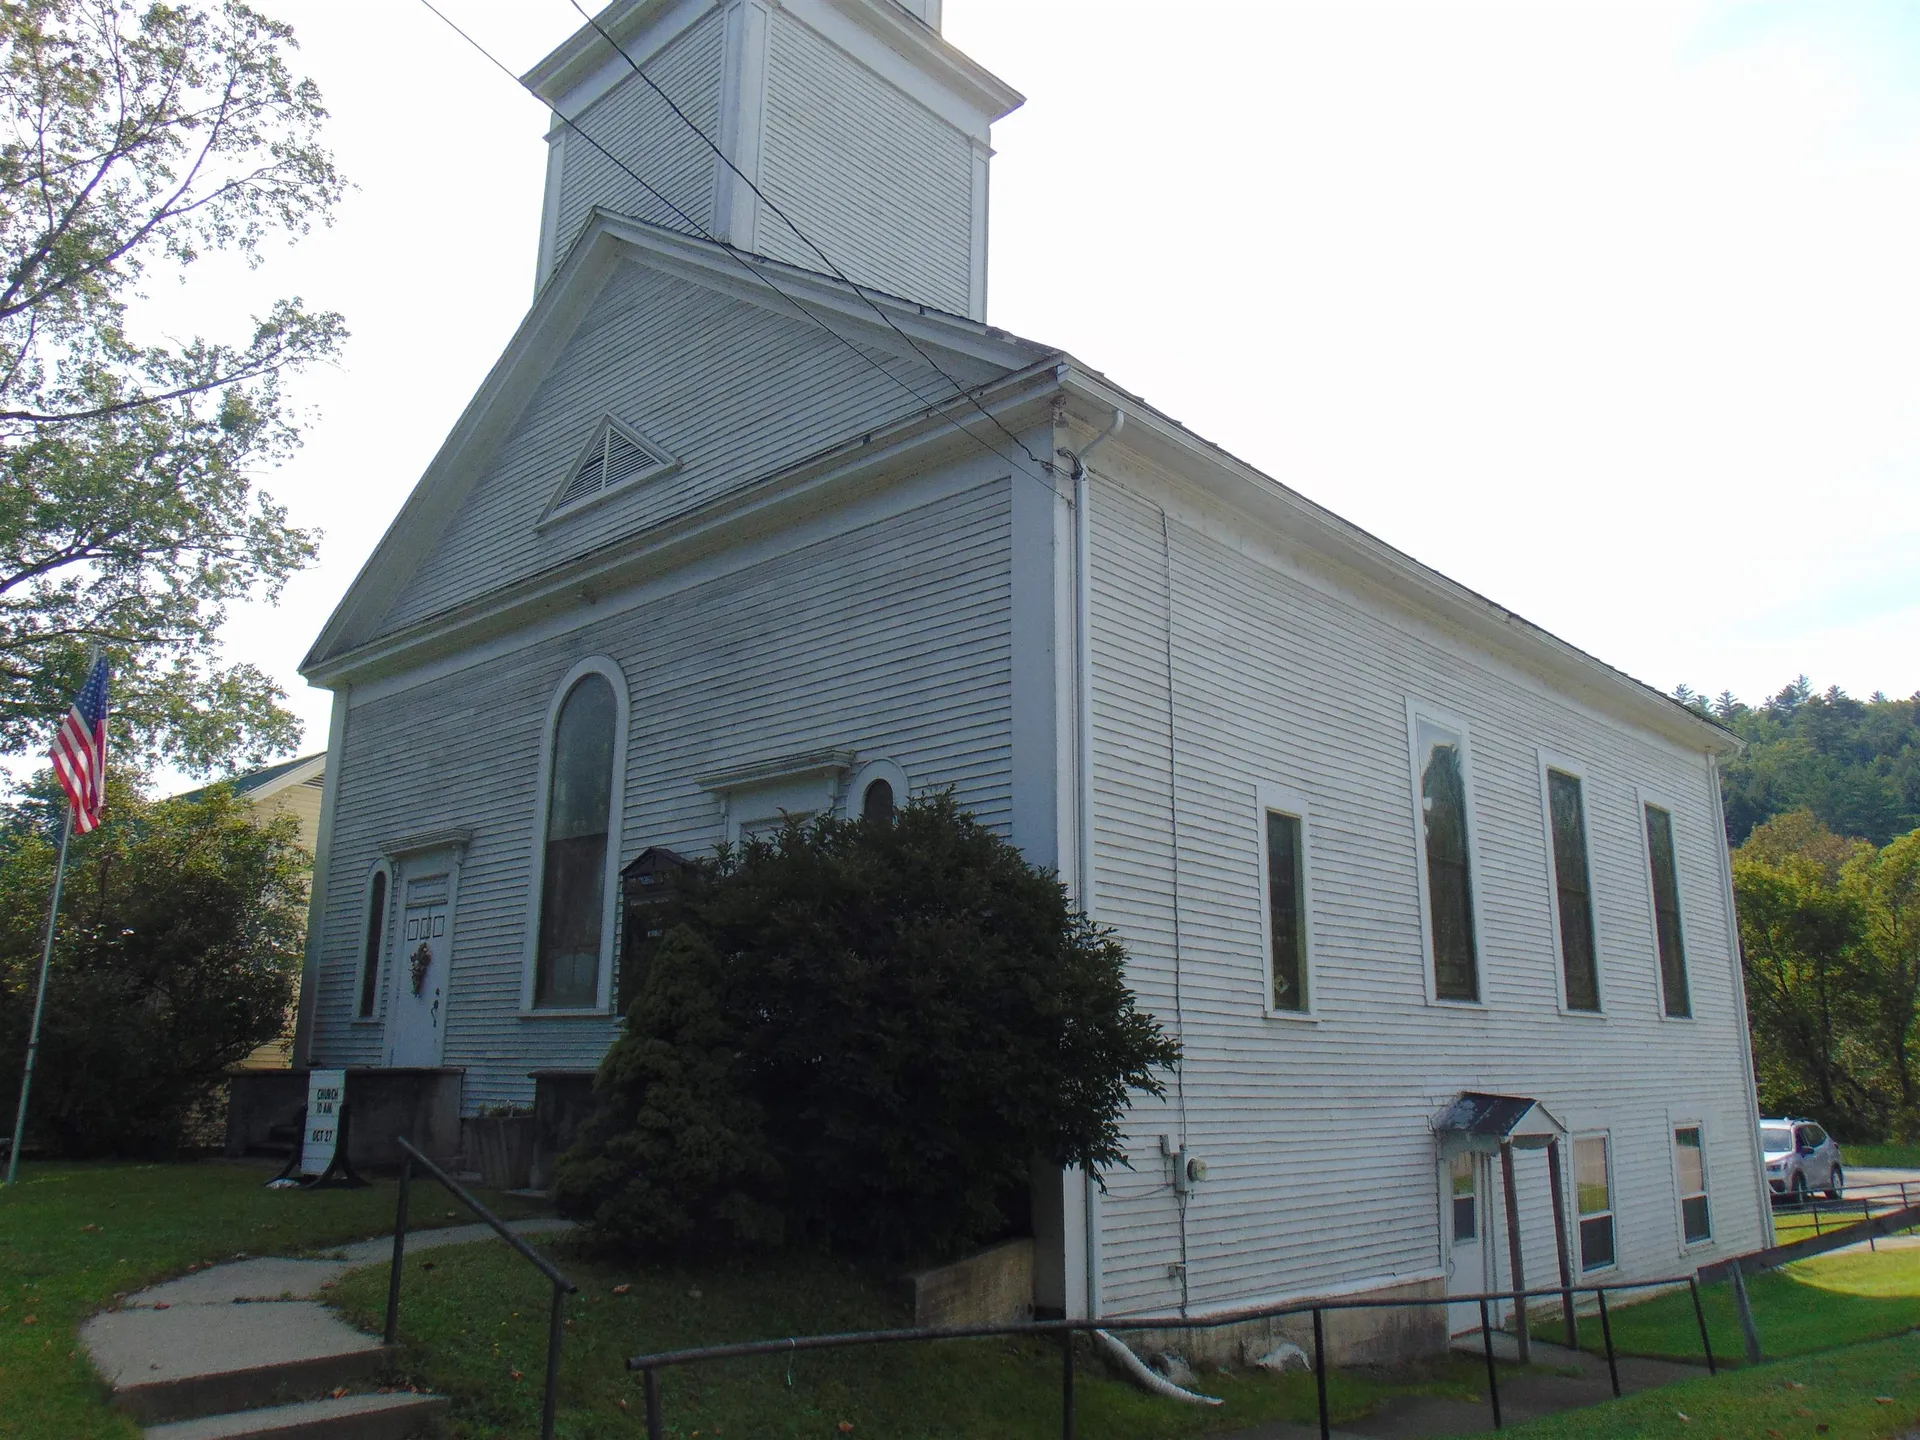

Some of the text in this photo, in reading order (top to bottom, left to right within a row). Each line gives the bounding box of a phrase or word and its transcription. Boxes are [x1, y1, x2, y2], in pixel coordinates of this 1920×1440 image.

[317, 1088, 339, 1100] CHURCH
[316, 1102, 333, 1114] 10 AM
[312, 1130, 333, 1142] OCT 27
